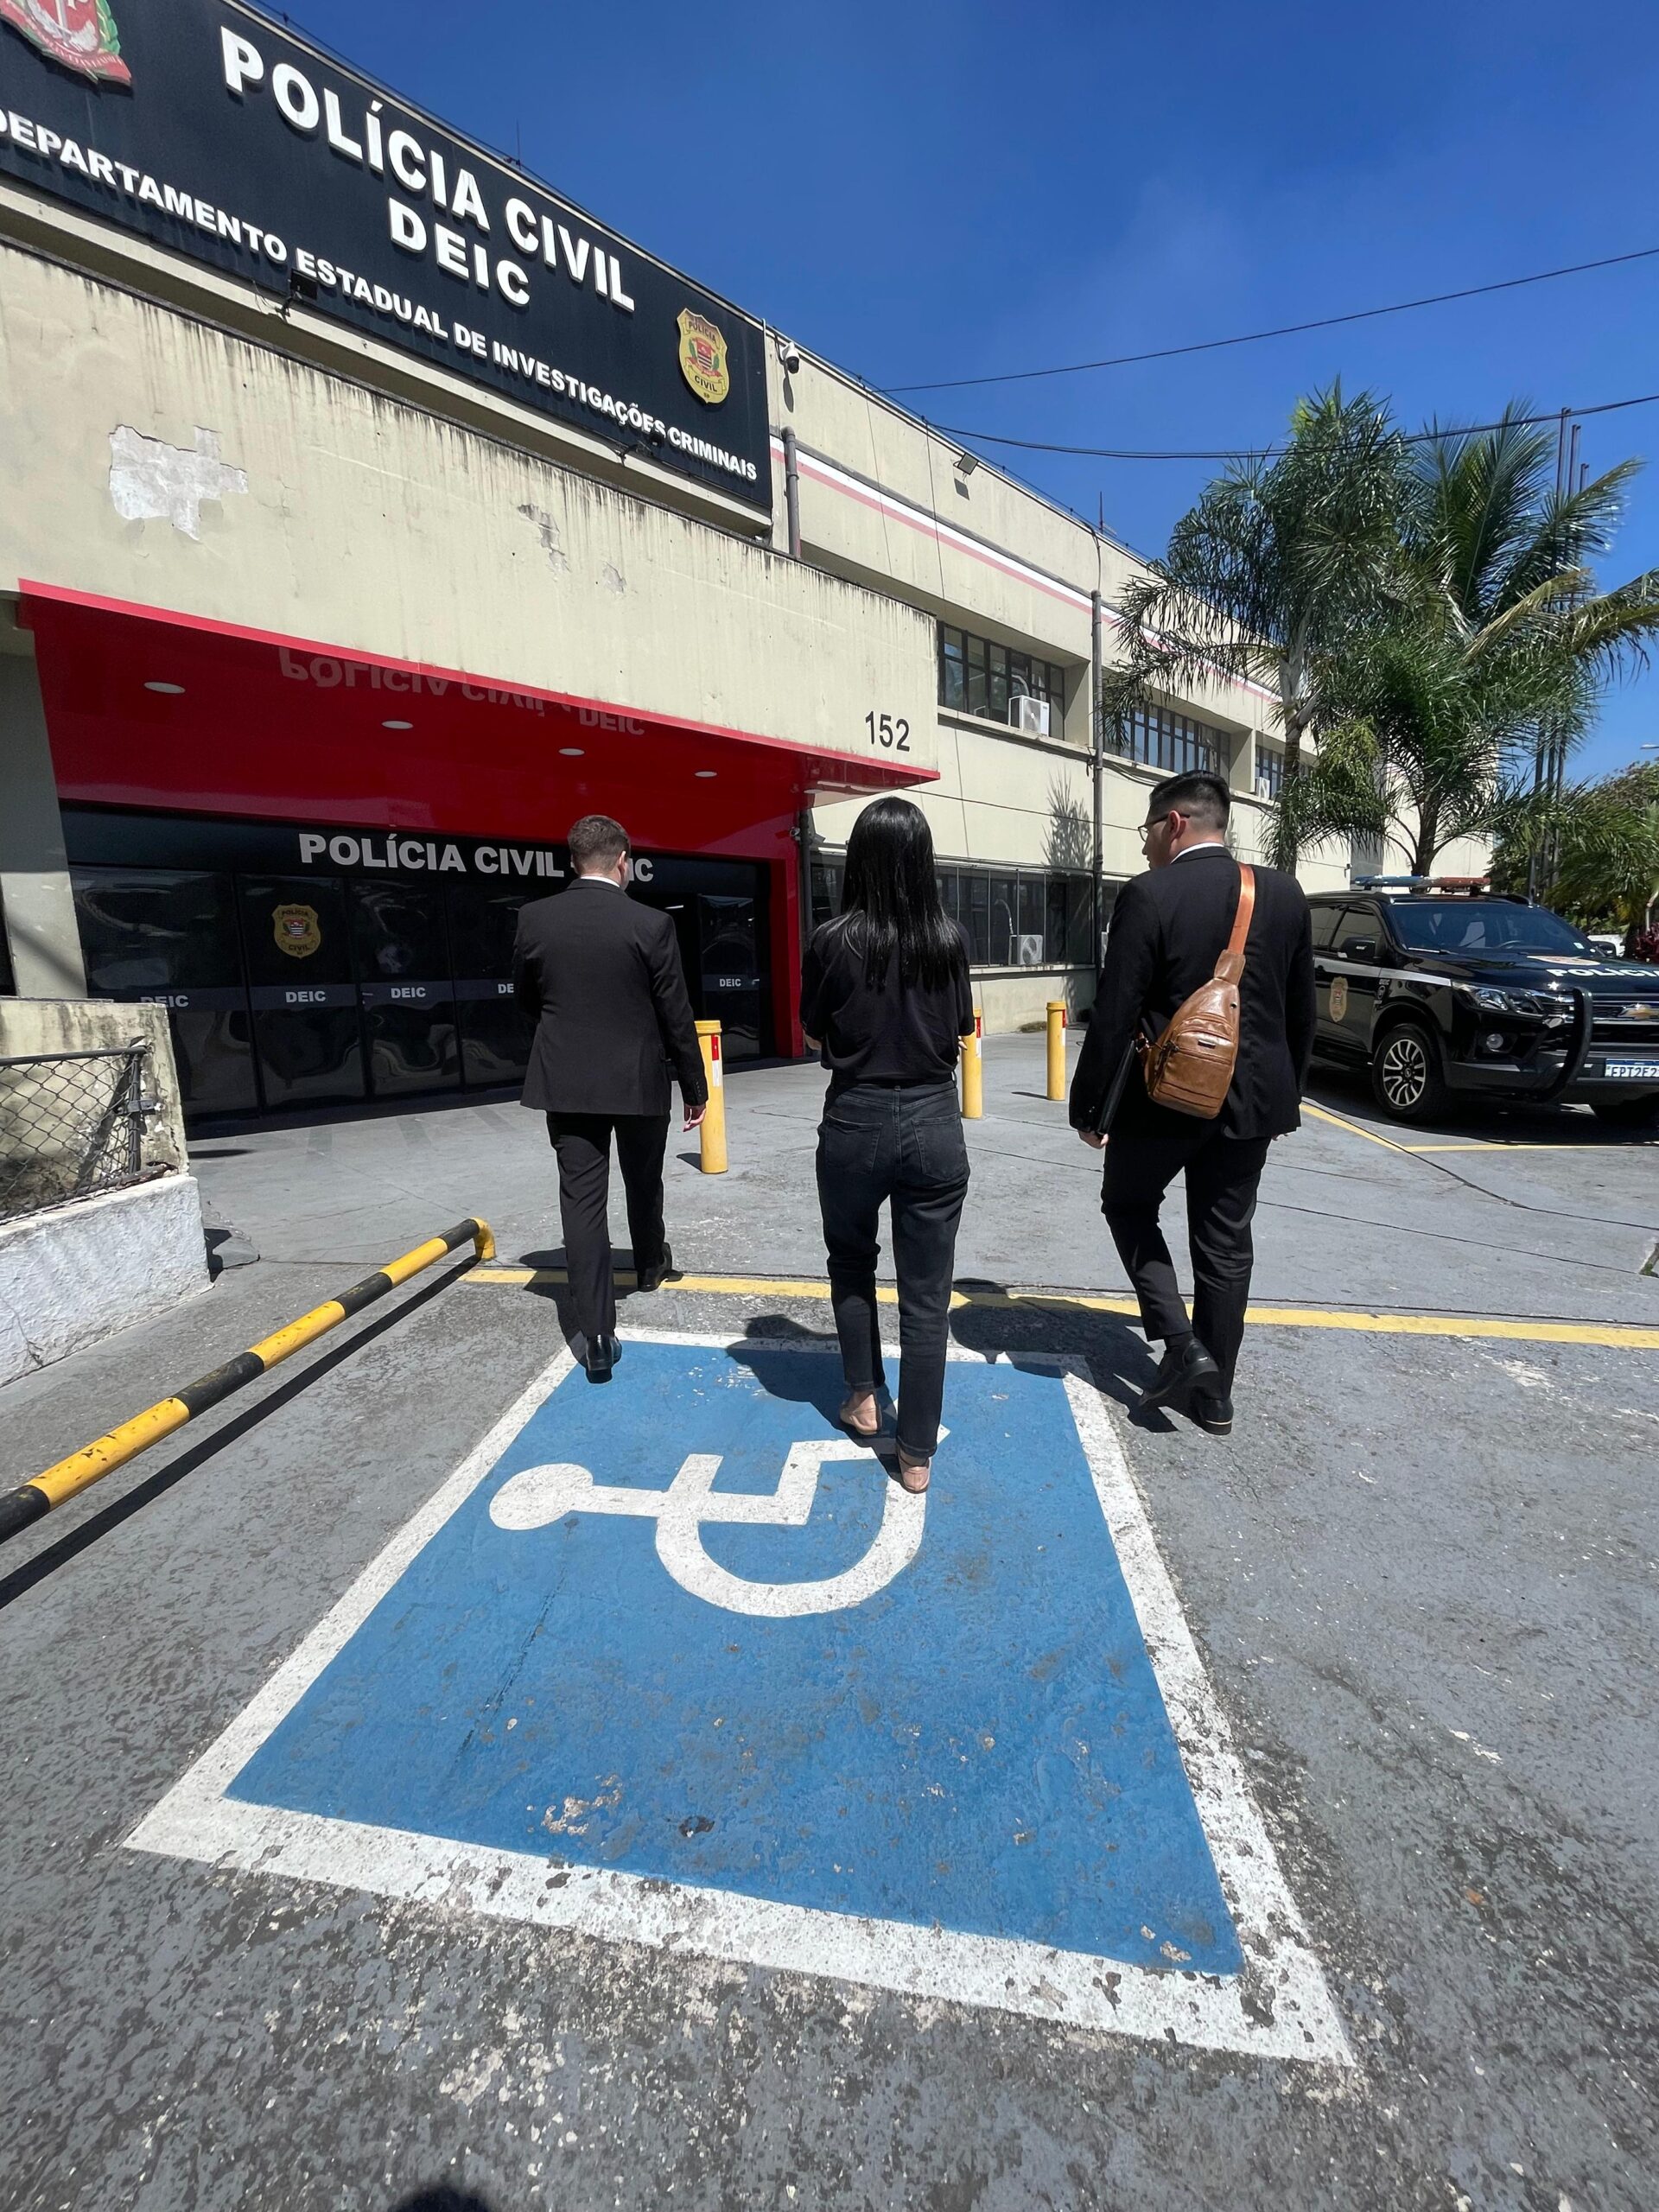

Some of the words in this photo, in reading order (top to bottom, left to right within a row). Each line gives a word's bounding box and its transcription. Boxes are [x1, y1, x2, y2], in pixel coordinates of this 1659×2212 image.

[220, 25, 490, 232] POLÍCIA
[505, 197, 635, 313] CIVIL
[388, 196, 531, 307] DEIC
[296, 247, 449, 340] ESTADUAL
[453, 321, 488, 358] DE
[493, 340, 666, 439] INVESTIGAÇÕES
[667, 426, 758, 481] CRIMINAIS
[694, 375, 718, 392] CIVIL
[865, 710, 911, 753] 152
[298, 833, 467, 872] POLÍCIA
[474, 846, 564, 878] CIVIL
[719, 978, 741, 987] DEIC
[1546, 968, 1659, 977] POLÍCI
[285, 990, 327, 1003] DEIC
[391, 987, 427, 999] DEIC
